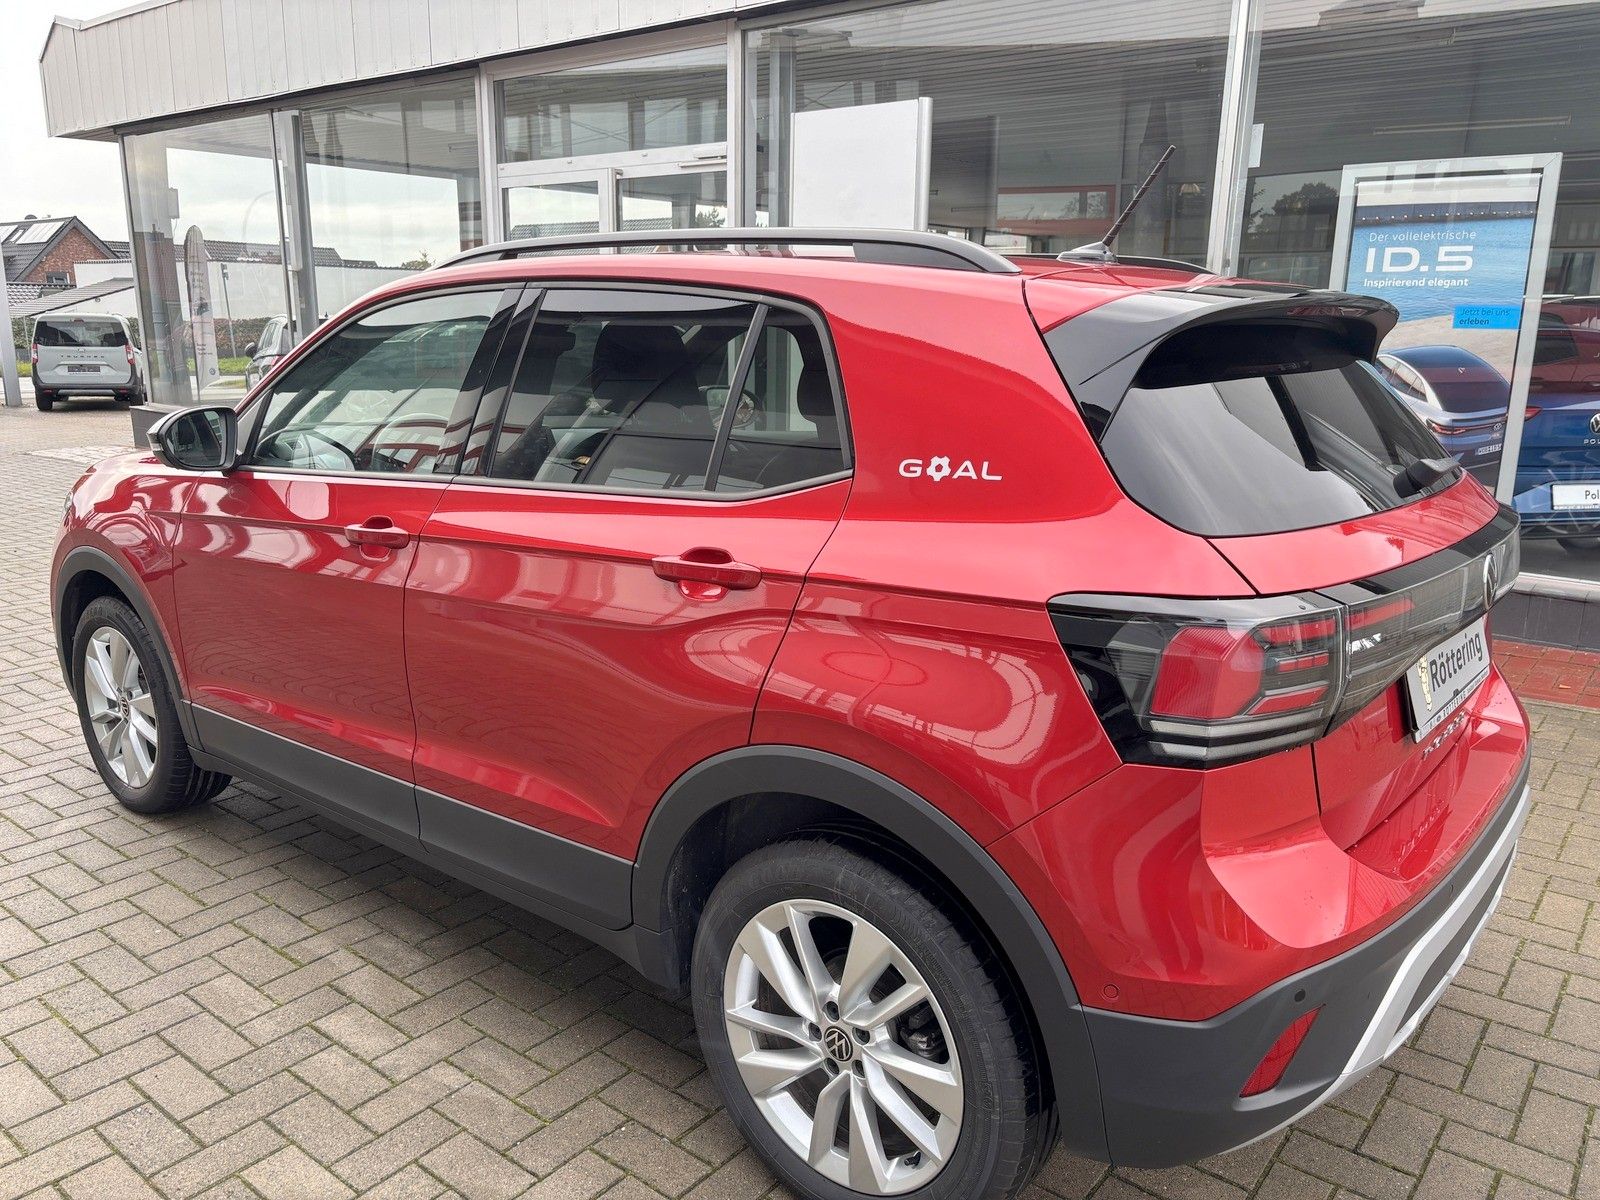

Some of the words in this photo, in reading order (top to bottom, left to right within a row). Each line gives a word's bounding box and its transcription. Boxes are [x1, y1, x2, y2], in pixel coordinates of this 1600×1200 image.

[1369, 232, 1388, 242] Der
[1392, 230, 1477, 241] vollelektrische
[1365, 245, 1474, 273] ID.5
[1363, 277, 1426, 288] Inspirierend
[1427, 277, 1470, 288] elegant
[1461, 307, 1480, 316] Jetzt
[1481, 307, 1494, 316] bei
[1496, 308, 1511, 316] uns
[1459, 317, 1490, 325] erleben
[898, 456, 1003, 481] GOAL
[1429, 632, 1483, 692] Röttering
